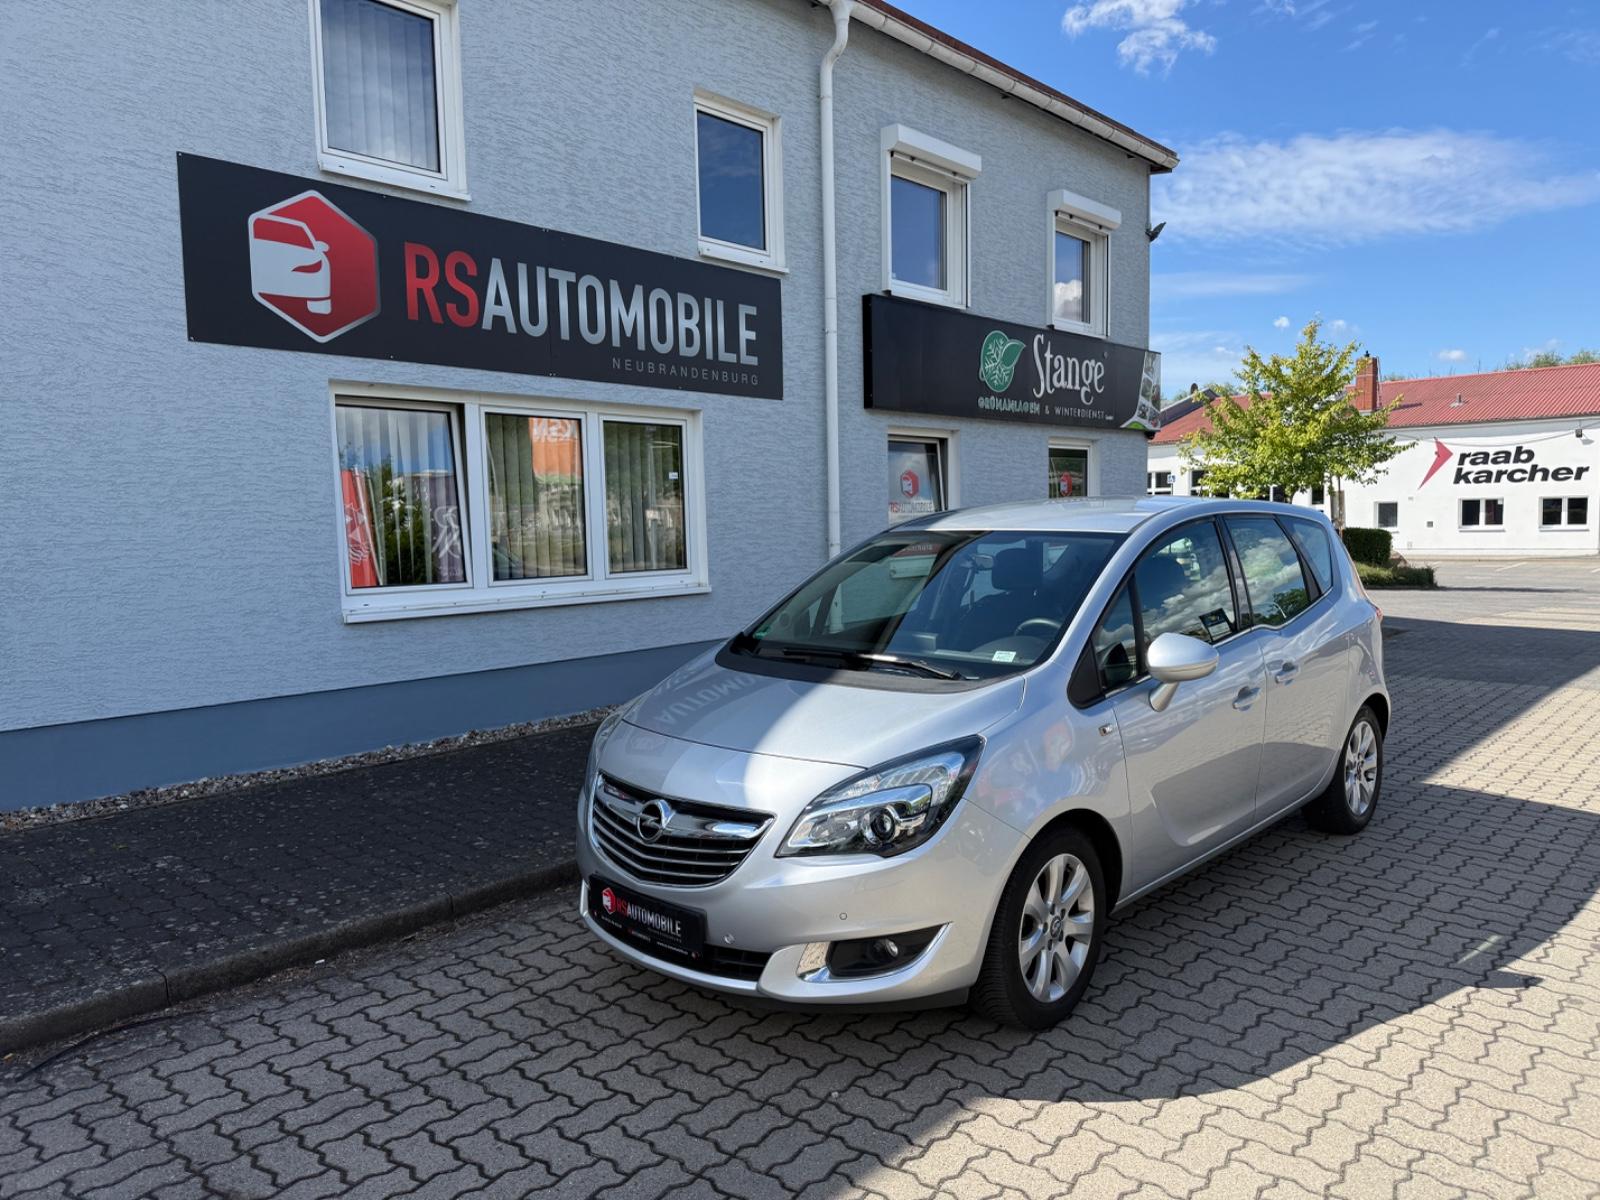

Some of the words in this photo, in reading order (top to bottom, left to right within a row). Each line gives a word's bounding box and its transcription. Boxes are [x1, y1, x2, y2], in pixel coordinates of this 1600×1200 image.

[612, 357, 759, 386] NEUBRANDENBURG
[1033, 333, 1105, 405] Stange
[1054, 406, 1104, 420] WINTERDIENST
[1457, 446, 1535, 466] raab
[1453, 464, 1590, 485] karcher
